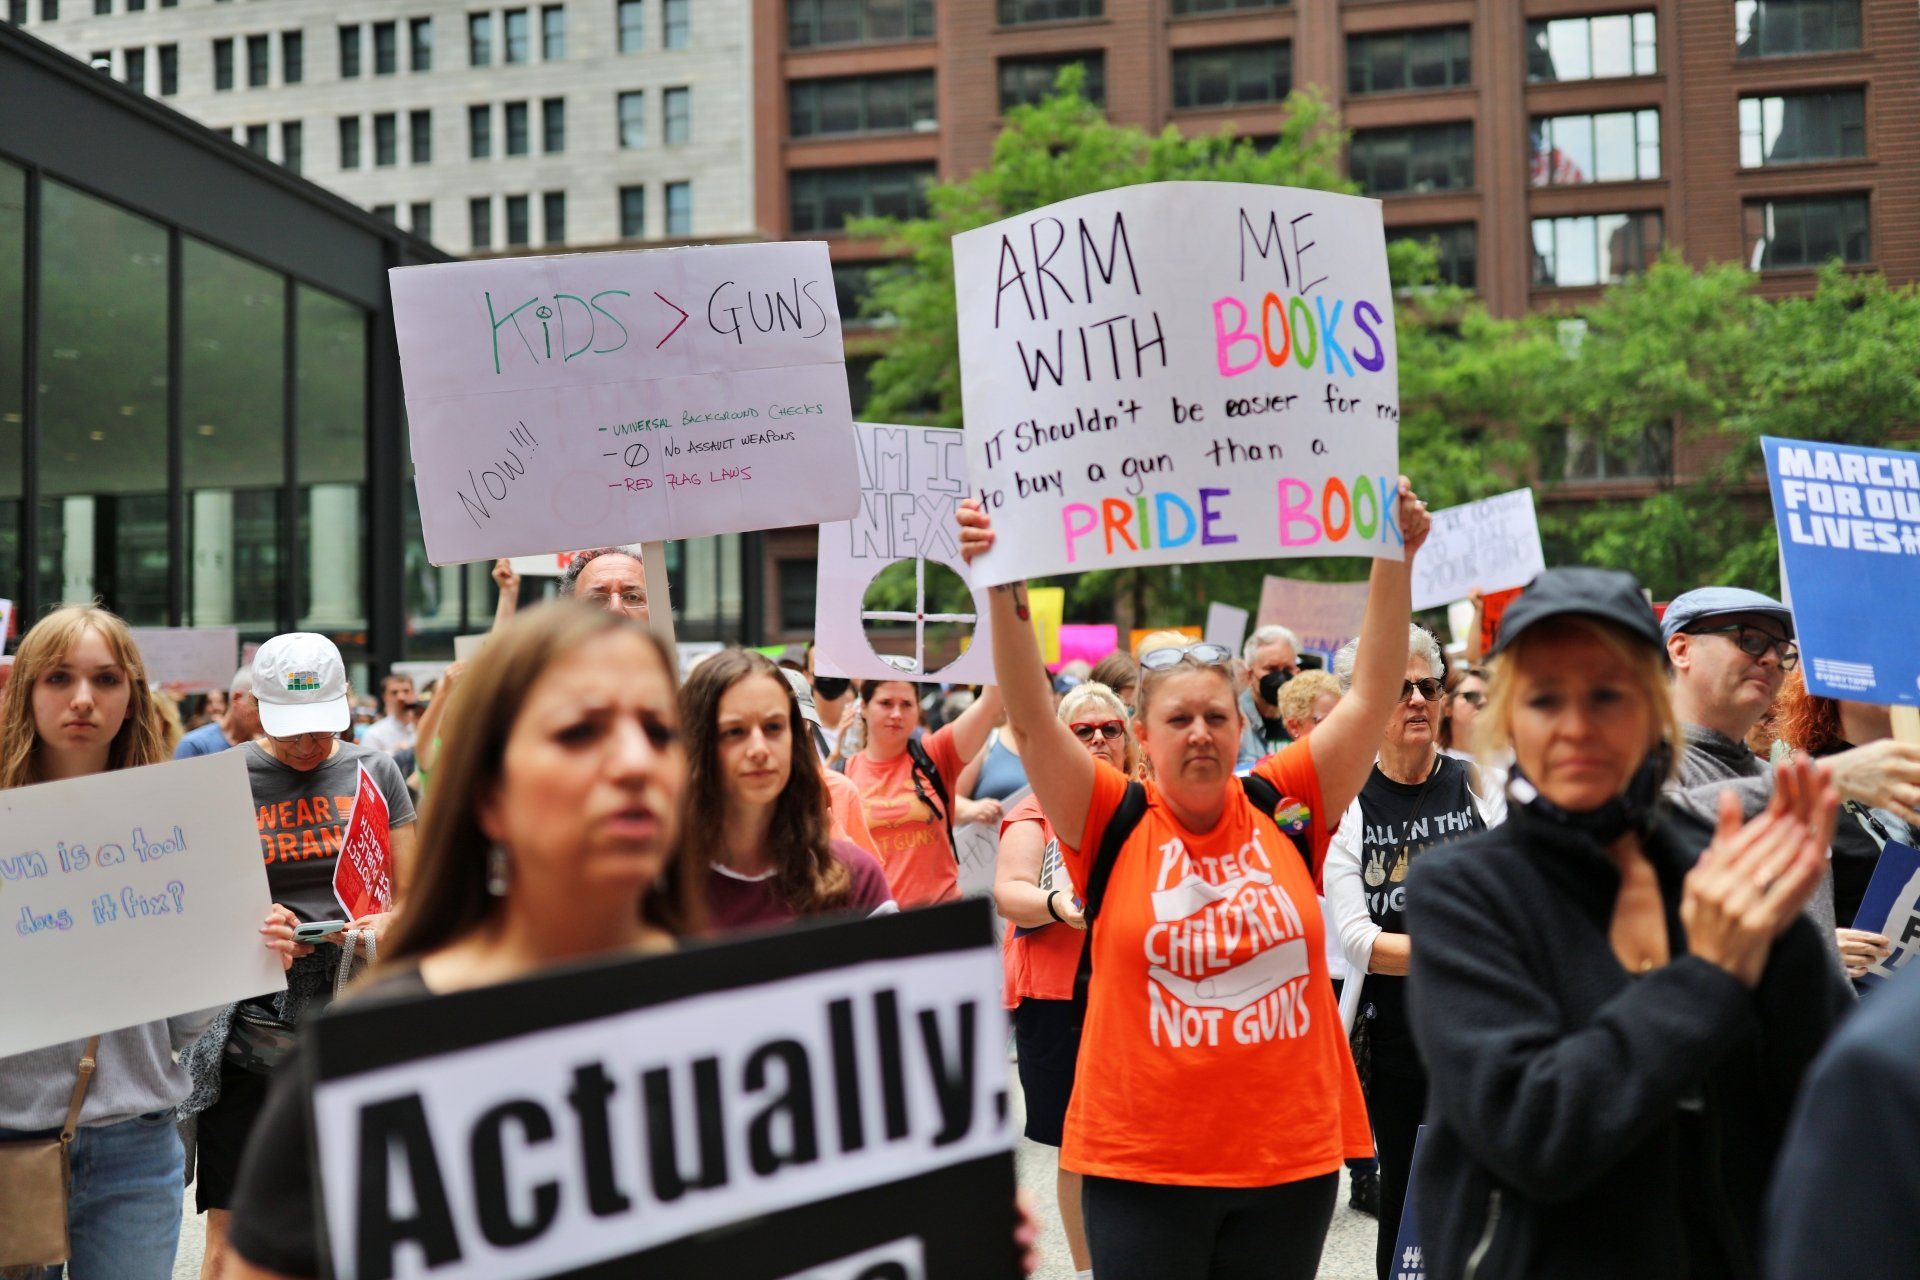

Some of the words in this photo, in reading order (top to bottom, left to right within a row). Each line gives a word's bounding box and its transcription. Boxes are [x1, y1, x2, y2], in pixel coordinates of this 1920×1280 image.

[994, 210, 1142, 329] ARM
[1239, 207, 1329, 295] ME
[707, 277, 827, 345] GUNS
[1016, 311, 1168, 392] WITH
[1211, 292, 1386, 378] BOOKS
[613, 417, 672, 436] UNIVERSAL
[682, 408, 759, 426] BACKGROUND
[768, 403, 824, 420] CHECKS
[985, 429, 1006, 470] IT
[1015, 399, 1143, 452] Shouldn't
[1172, 396, 1205, 424] be
[1225, 392, 1299, 418] easier
[1323, 382, 1361, 414] for
[686, 438, 734, 454] ASSAULT
[924, 429, 963, 493] I
[1777, 446, 1920, 489] MARCH
[626, 477, 653, 492] RED
[710, 466, 753, 483] LAWS
[976, 488, 1005, 514] to
[1015, 470, 1065, 499] buy
[1087, 462, 1106, 482] a
[1121, 453, 1175, 497] gun
[1204, 436, 1284, 467] than
[1312, 438, 1329, 456] a
[1781, 478, 1864, 518] FOR
[850, 489, 972, 559] NEX
[1061, 487, 1239, 564] PRIDE
[1787, 512, 1901, 555] LIVES
[257, 796, 333, 830] WEAR
[1364, 824, 1399, 846] ALL
[57, 841, 91, 873] is
[96, 843, 125, 868] a
[132, 826, 188, 864] tool
[260, 825, 347, 865] ORAN
[360, 815, 385, 866] HEALTH
[16, 905, 75, 937] does
[91, 893, 118, 927] it
[120, 880, 185, 919] fix?
[1147, 979, 1224, 1048] NOT
[1232, 977, 1311, 1046] GUNS
